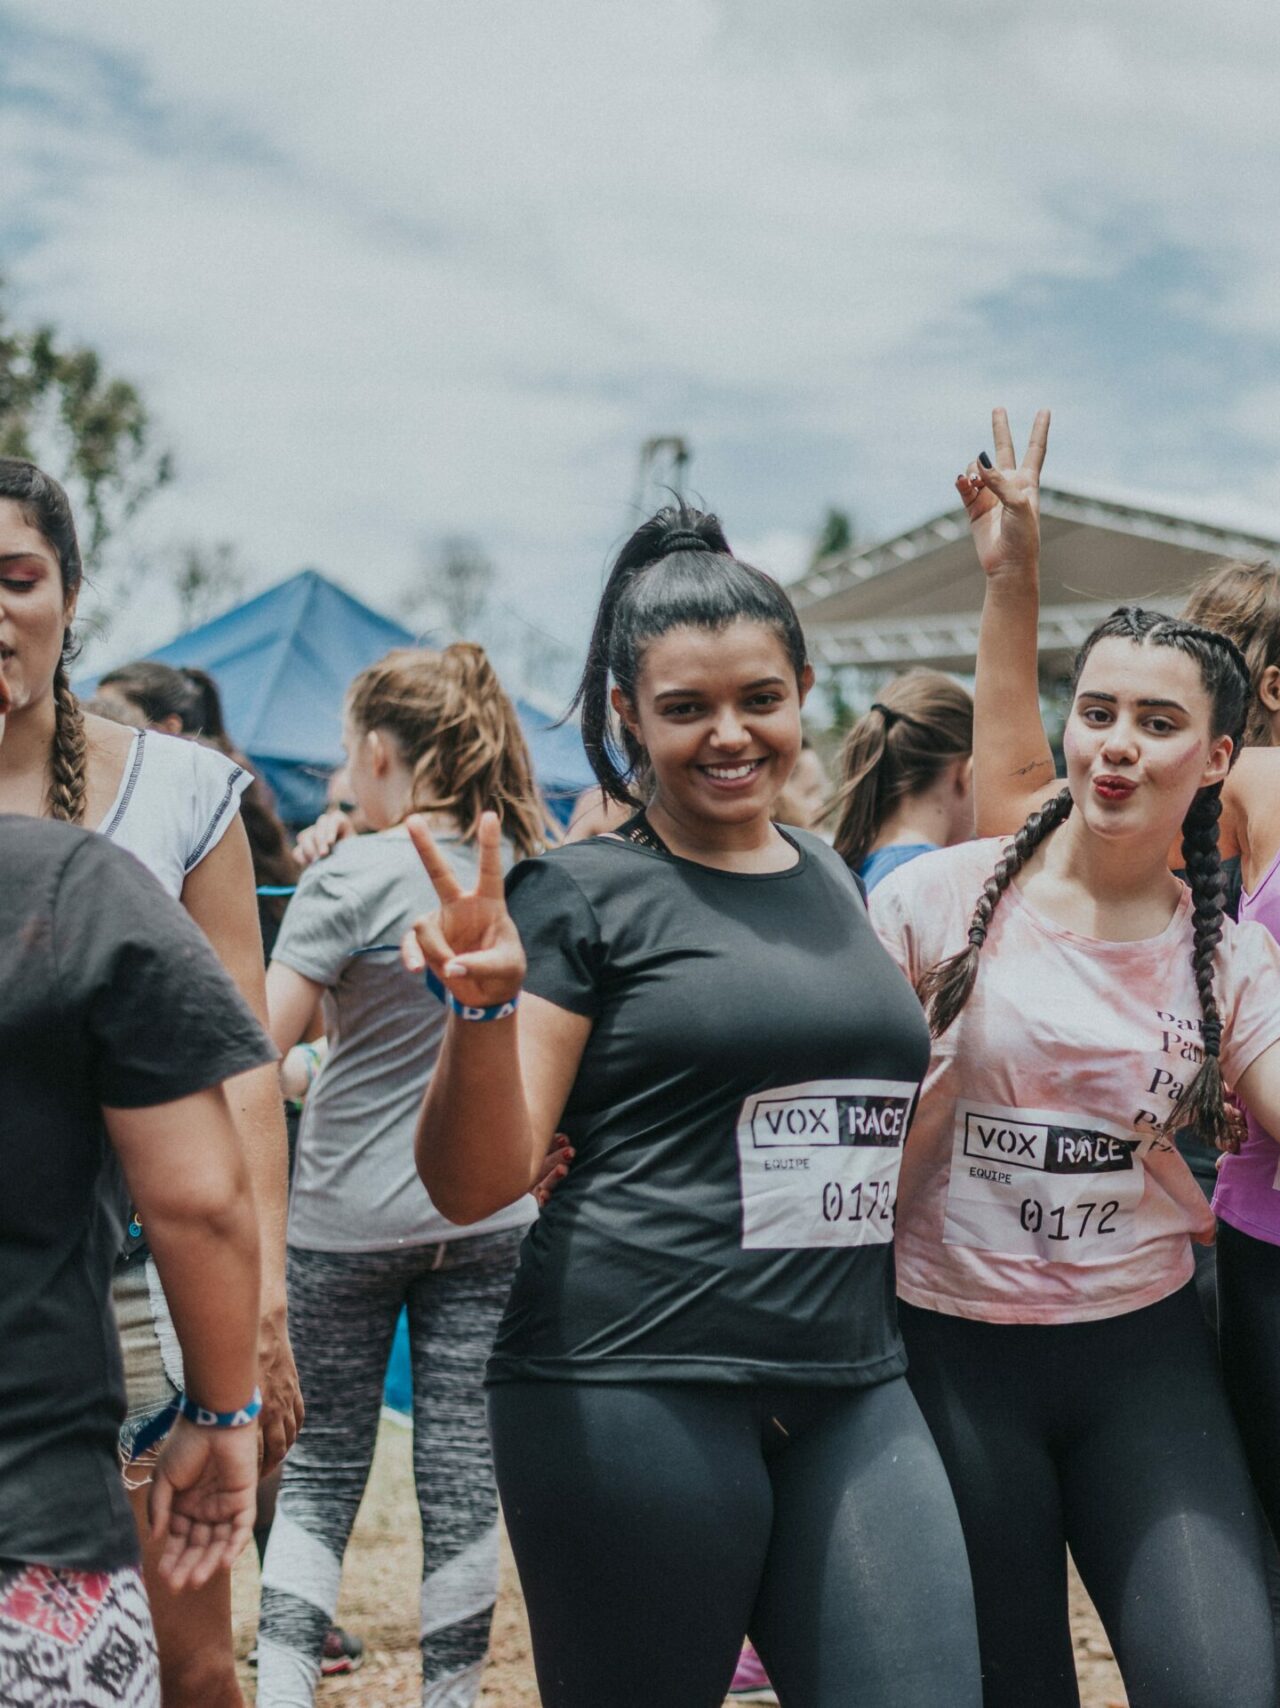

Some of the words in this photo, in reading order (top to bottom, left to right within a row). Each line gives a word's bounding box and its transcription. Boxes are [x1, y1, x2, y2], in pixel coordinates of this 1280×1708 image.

[765, 1107, 830, 1136] VOX
[847, 1105, 903, 1137] RACE
[977, 1125, 1038, 1159] VOX
[1056, 1136, 1124, 1164] RACE
[764, 1158, 810, 1171] EQUIPE
[968, 1166, 1012, 1185] EQUIPE
[822, 1180, 891, 1222] 0172
[1019, 1198, 1120, 1241] 0172
